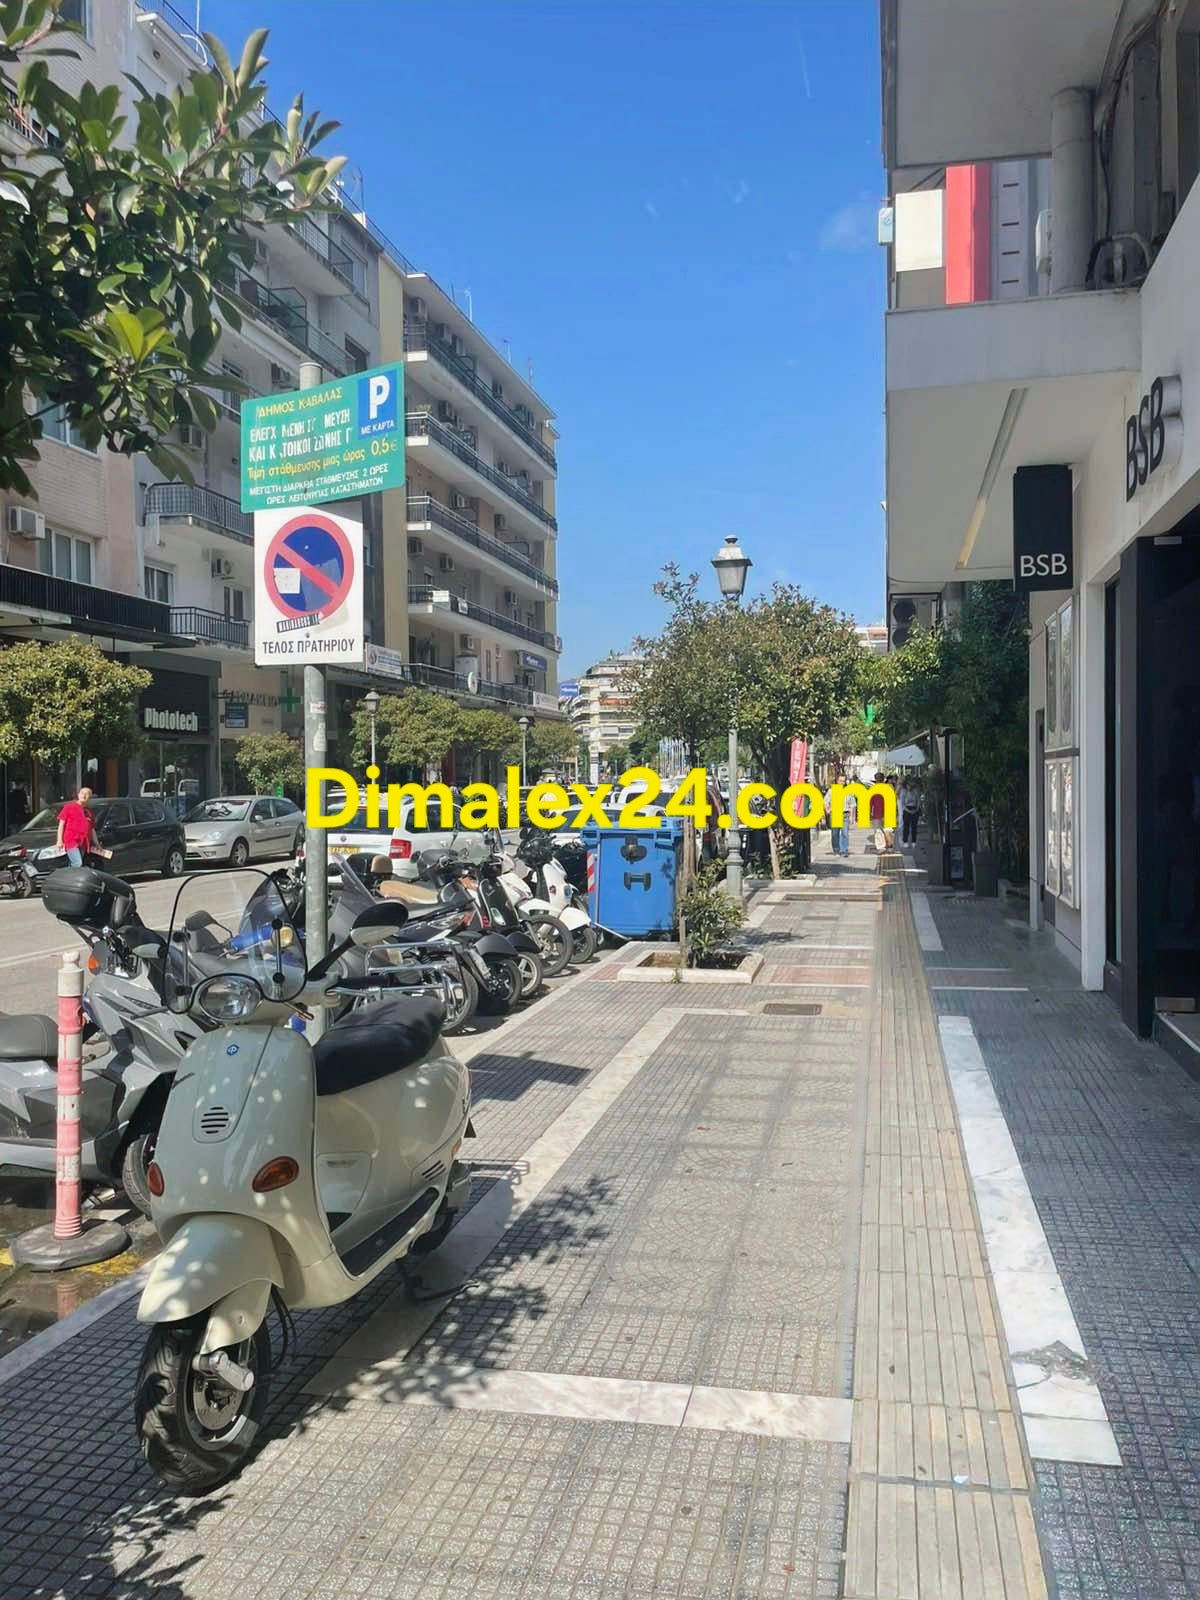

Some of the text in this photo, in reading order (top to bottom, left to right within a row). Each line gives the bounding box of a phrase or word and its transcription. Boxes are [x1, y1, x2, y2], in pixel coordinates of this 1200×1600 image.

[258, 386, 343, 417] ΔΗΜΟΣ ΚΑΒΑΛΑΣ
[369, 375, 391, 420] P
[1126, 376, 1165, 503] BSB
[249, 446, 266, 462] ΚΑΙ
[1020, 553, 1068, 577] BSB
[263, 638, 355, 654] ΤΕΛΟΣ ΠΡΑΤΗΡΙΟΥ
